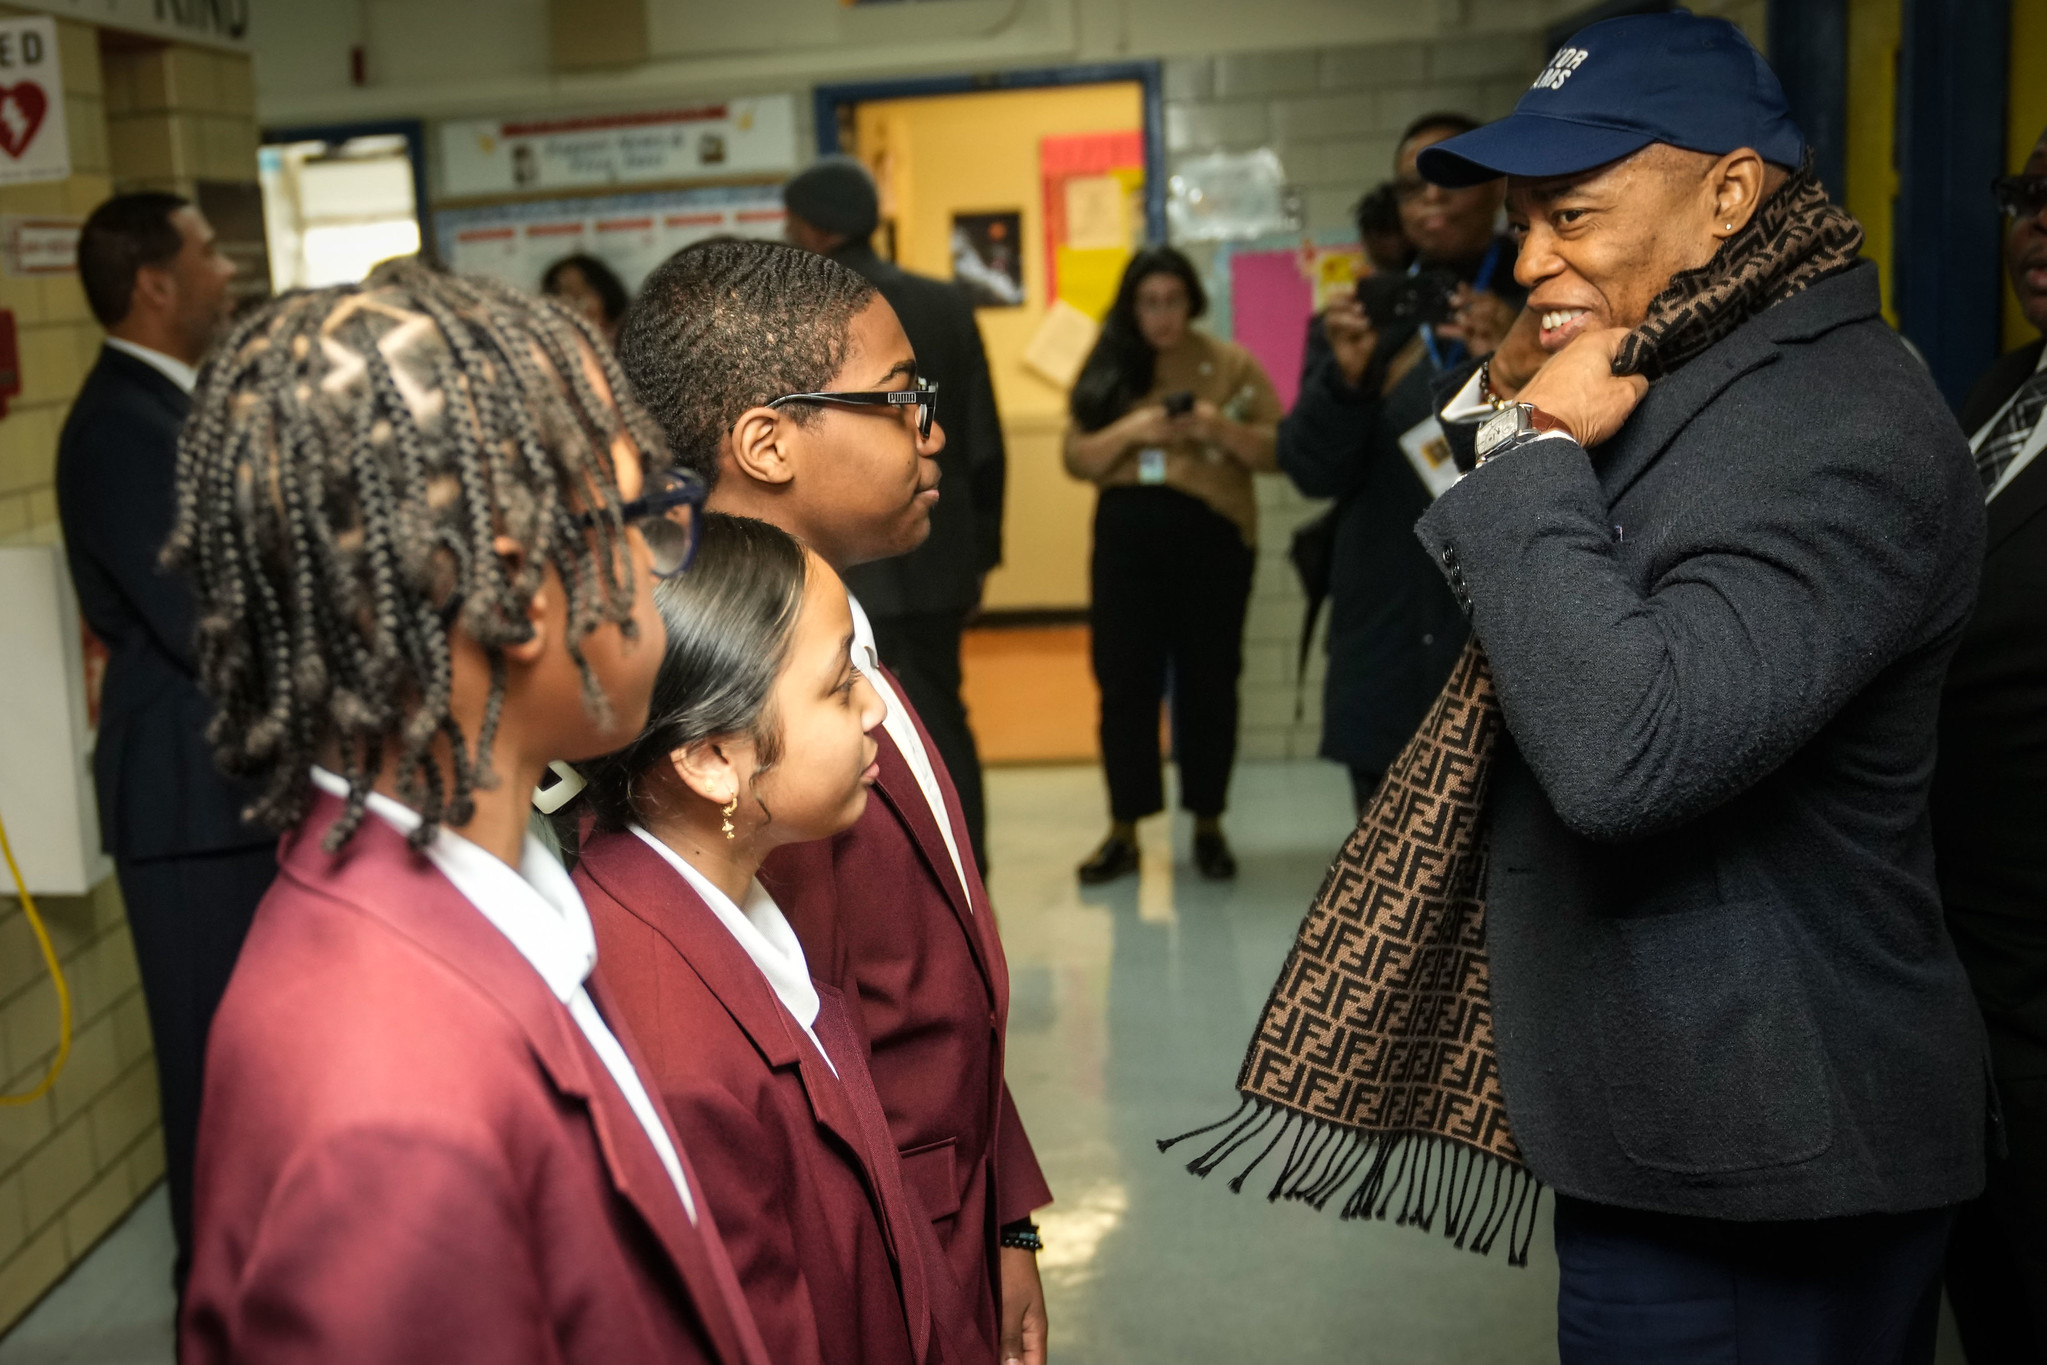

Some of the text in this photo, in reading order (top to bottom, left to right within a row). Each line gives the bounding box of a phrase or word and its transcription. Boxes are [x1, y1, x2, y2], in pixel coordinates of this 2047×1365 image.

[0, 30, 44, 66] ED
[1548, 47, 1588, 70] YOR
[1532, 67, 1572, 90] AMS
[888, 392, 917, 403] PUMA
